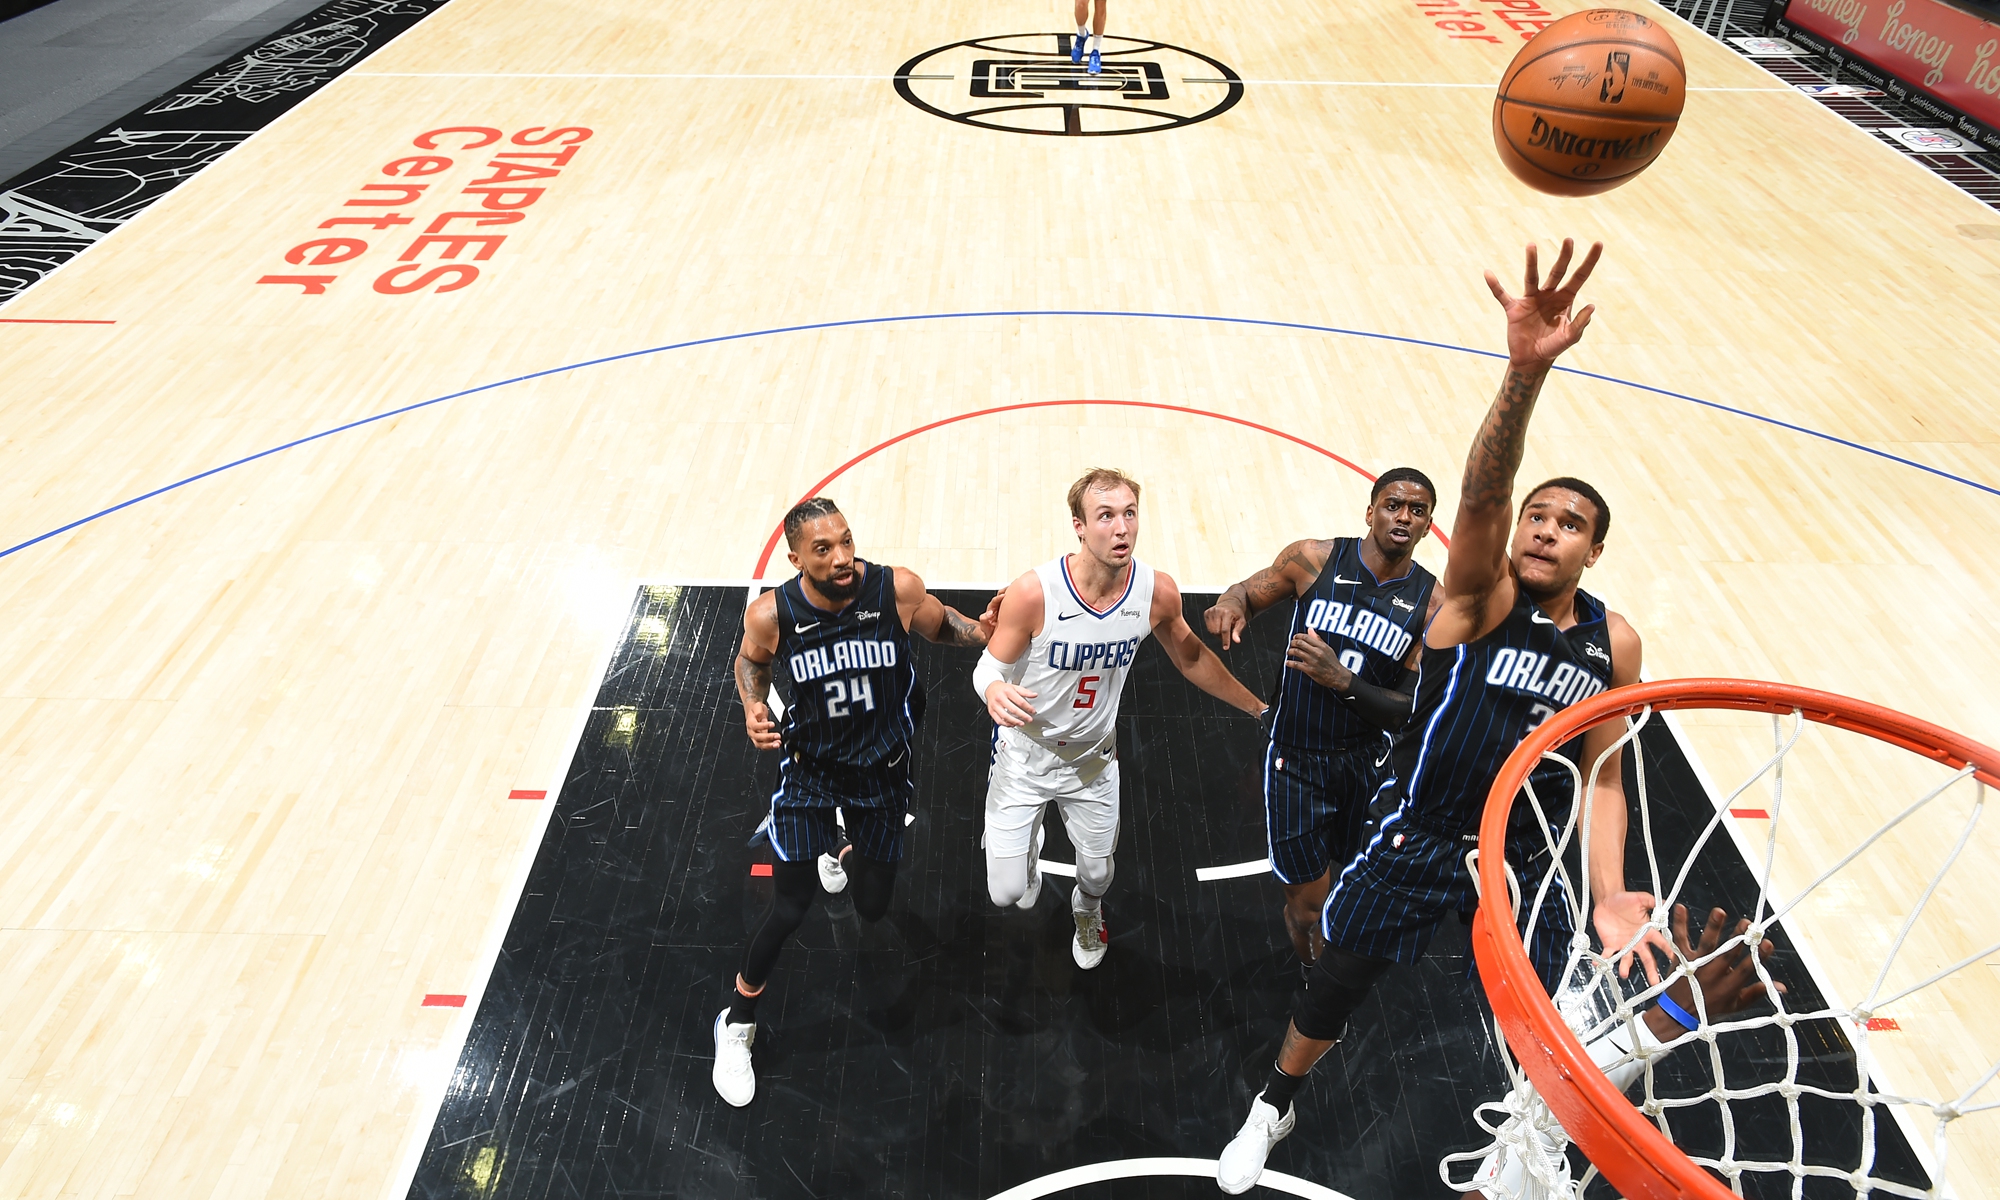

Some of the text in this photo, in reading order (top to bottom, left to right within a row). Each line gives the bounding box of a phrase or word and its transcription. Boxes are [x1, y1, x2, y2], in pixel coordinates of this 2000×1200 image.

[1879, 0, 1953, 86] honey
[1792, 30, 1826, 54] JoinHoney.com
[1846, 60, 1884, 86] JoinHoney.com
[1888, 79, 1907, 102] honey
[1910, 94, 1955, 123] JoinHoney.com
[1957, 115, 1980, 140] honey
[1527, 114, 1661, 160] SPALDING
[255, 126, 503, 295] Center
[372, 126, 594, 295] STAPLES
[855, 610, 881, 621] Disney
[1120, 608, 1141, 619] honey
[1391, 594, 1415, 613] Disney
[1305, 599, 1413, 662] ORLANDO
[789, 639, 897, 684] ORLANDO
[1049, 636, 1140, 671] CLIPPERS
[1585, 642, 1610, 665] Disney
[823, 675, 875, 718] 24
[1073, 676, 1100, 709] 5
